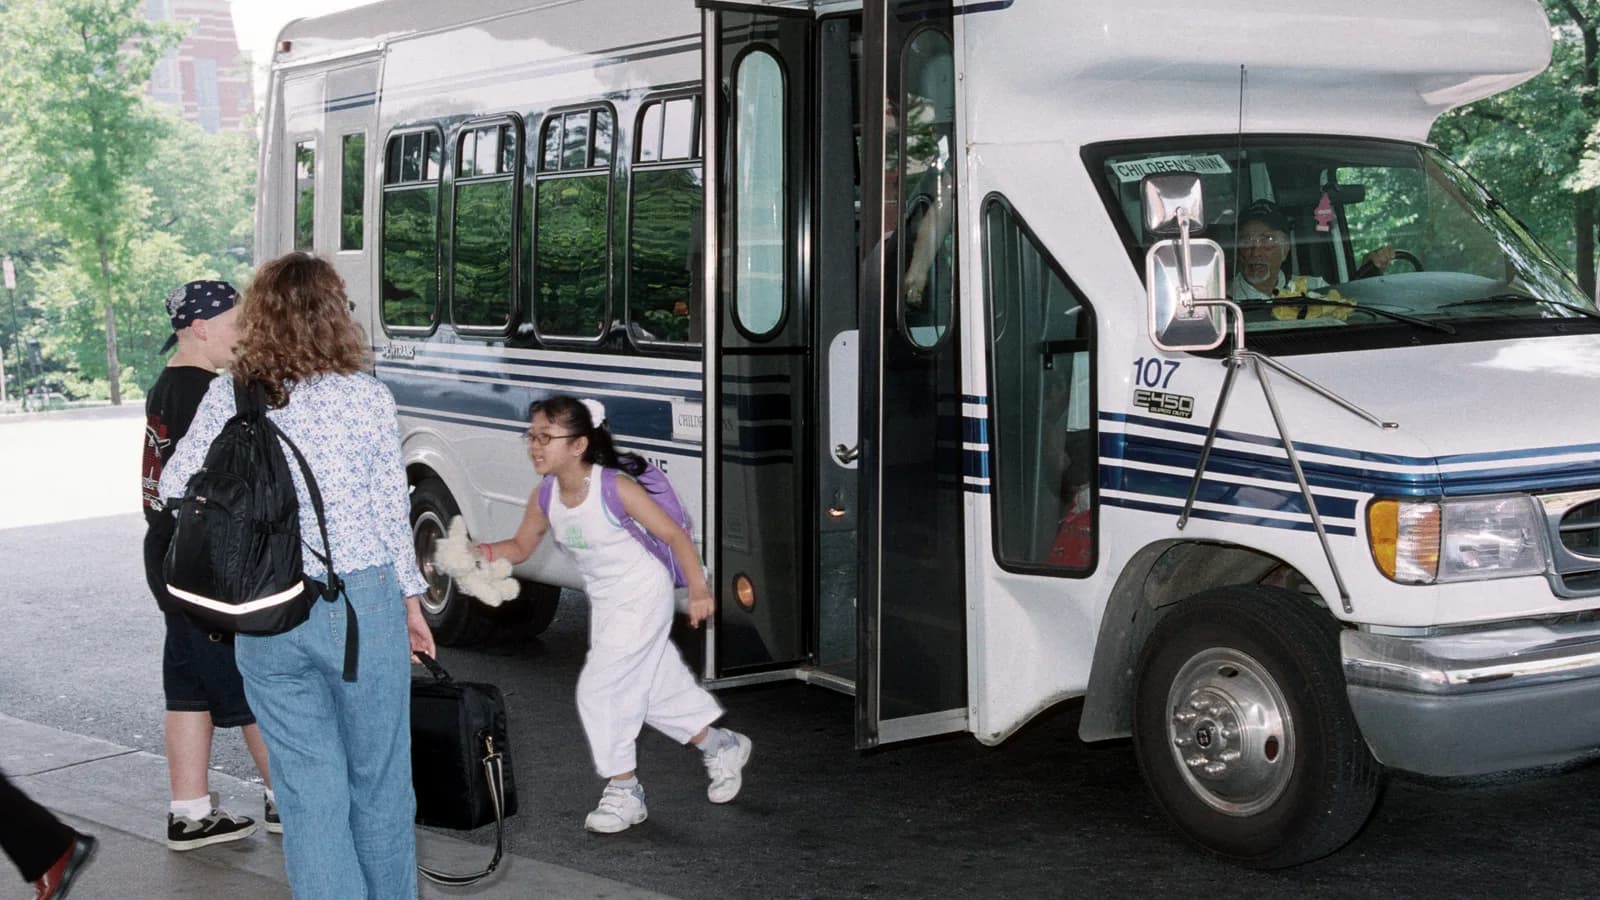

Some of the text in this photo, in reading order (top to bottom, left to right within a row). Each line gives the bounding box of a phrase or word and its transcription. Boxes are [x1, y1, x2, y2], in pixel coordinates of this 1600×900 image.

[1117, 157, 1222, 176] CHILDREN'S INN
[1133, 357, 1181, 388] 107
